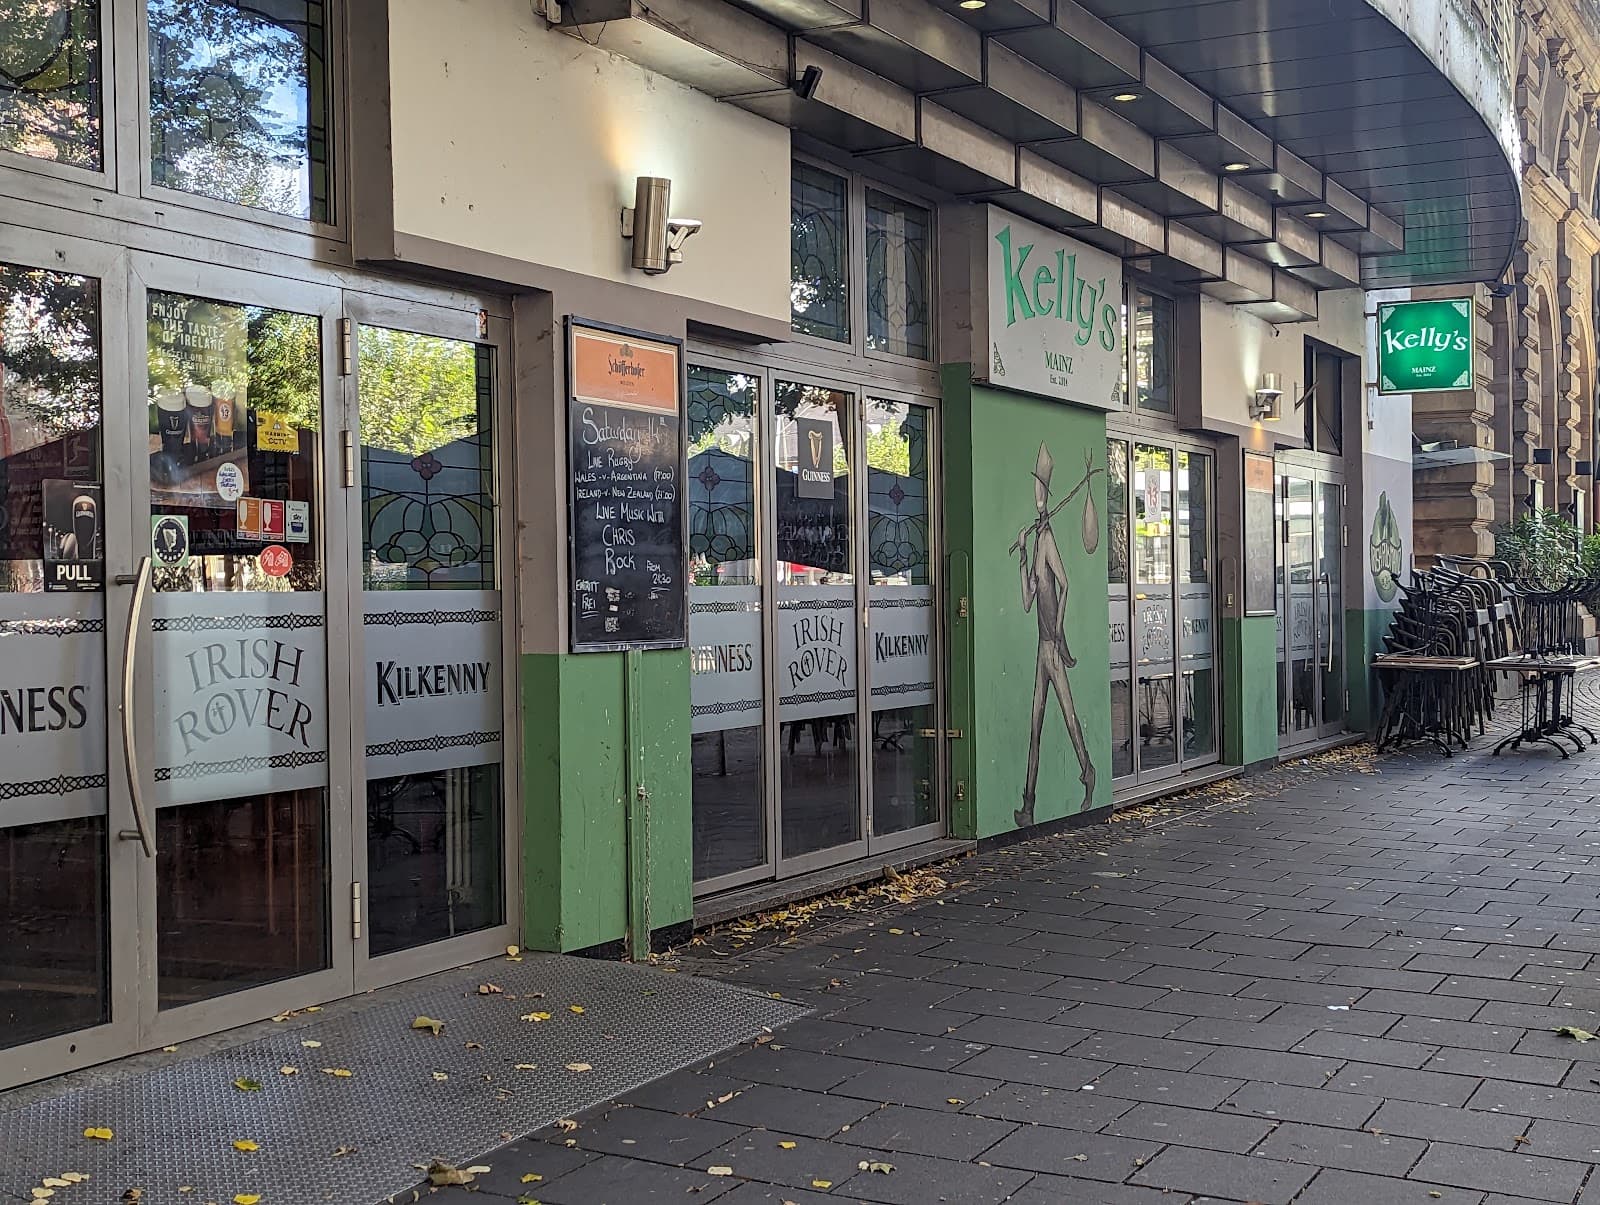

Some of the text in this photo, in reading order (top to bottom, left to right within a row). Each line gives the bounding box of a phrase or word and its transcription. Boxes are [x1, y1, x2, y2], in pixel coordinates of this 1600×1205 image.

[995, 225, 1117, 352] Kelly's
[152, 302, 187, 320] ENJOY
[163, 318, 219, 338] THE TASTE
[163, 330, 224, 352] OF IRELAND
[1383, 327, 1468, 354] Kelly's
[1044, 350, 1073, 375] MAINZ
[583, 407, 641, 464] Saturday
[802, 468, 830, 483] GUINNESS
[602, 524, 636, 547] CHRIS
[56, 564, 92, 581] PULL
[605, 548, 637, 575] ROCK
[792, 612, 845, 650] IRISH
[875, 632, 929, 663] KILKENNY
[184, 638, 304, 694] IRISH
[787, 647, 848, 690] ROVER
[374, 659, 492, 708] KILKENNY
[174, 687, 313, 756] ROVER
